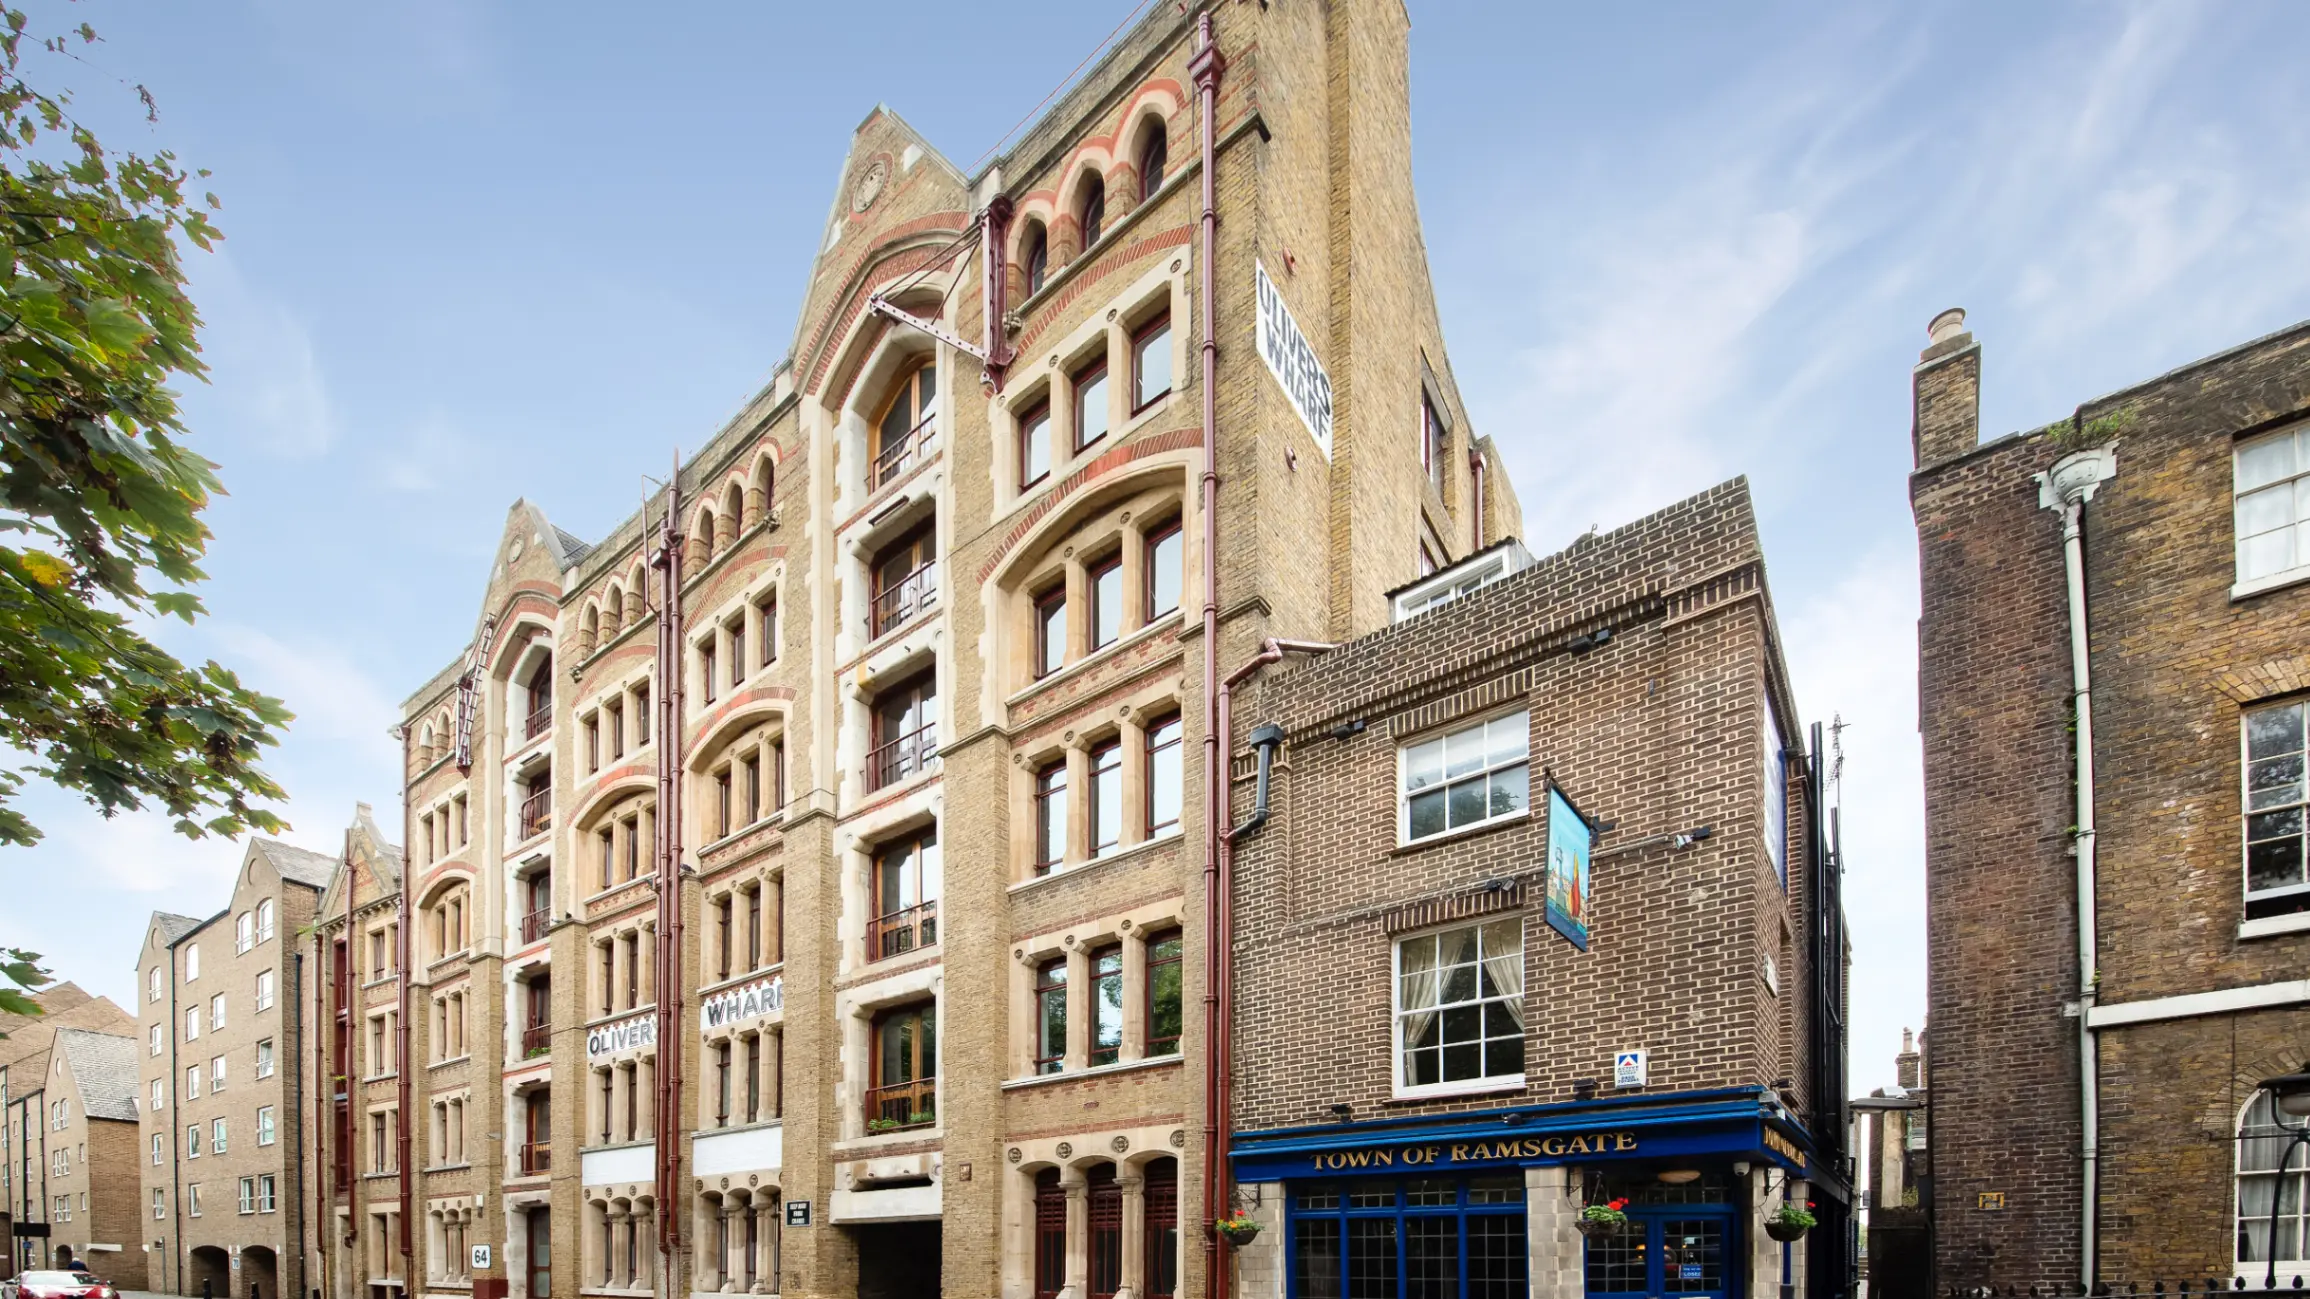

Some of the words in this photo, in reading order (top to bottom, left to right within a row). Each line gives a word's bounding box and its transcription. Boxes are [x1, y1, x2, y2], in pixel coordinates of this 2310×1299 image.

[1258, 269, 1331, 416] OLIVERS
[1265, 317, 1329, 438] WHARF
[589, 1019, 657, 1055] OLIVER
[1310, 1149, 1395, 1170] TOWN
[1402, 1146, 1441, 1165] OF
[1450, 1131, 1638, 1161] RAMSGATE
[475, 1250, 487, 1264] 64
